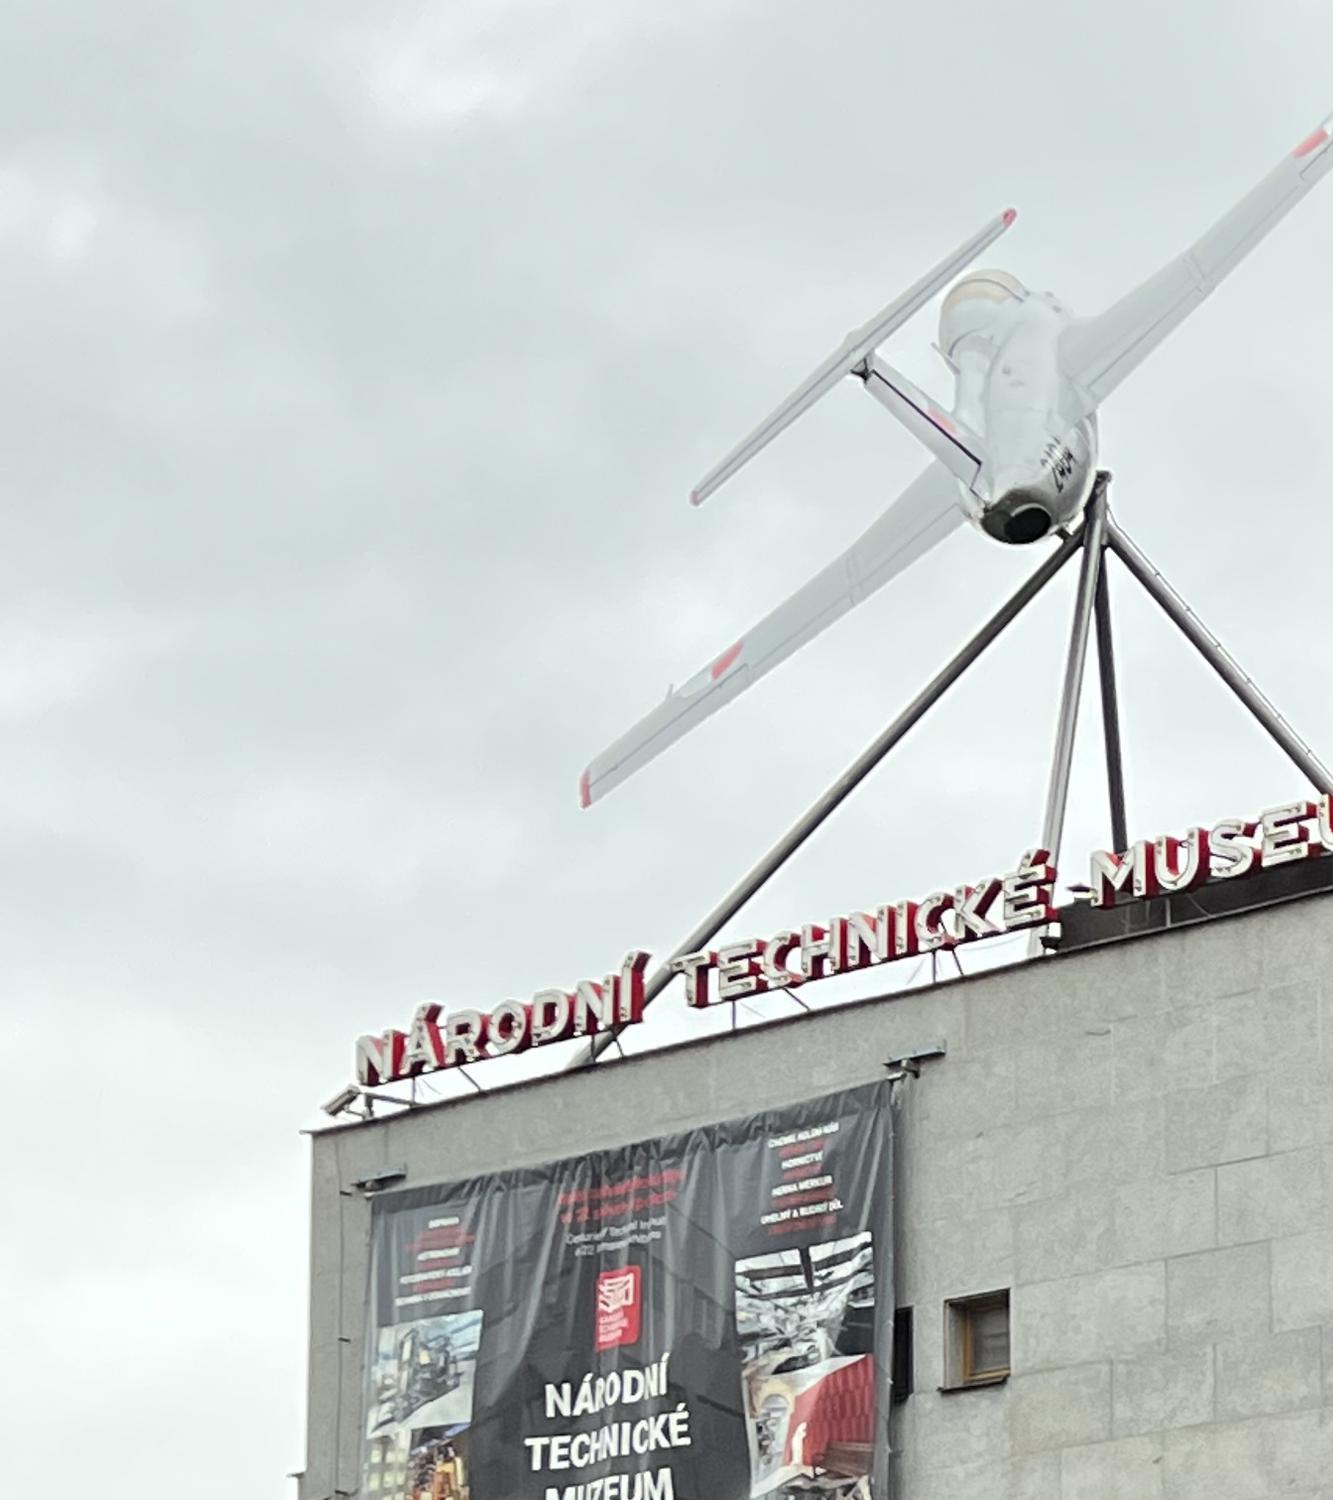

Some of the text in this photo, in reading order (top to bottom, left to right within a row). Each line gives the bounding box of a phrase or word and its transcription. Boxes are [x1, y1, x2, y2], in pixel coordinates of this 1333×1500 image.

[355, 949, 652, 1087] NÁRODNÍ
[670, 848, 1060, 1009] TECHNICKÉ
[544, 1351, 671, 1418] NÁRODNÍ
[523, 1402, 692, 1471] TECHNICKÉ
